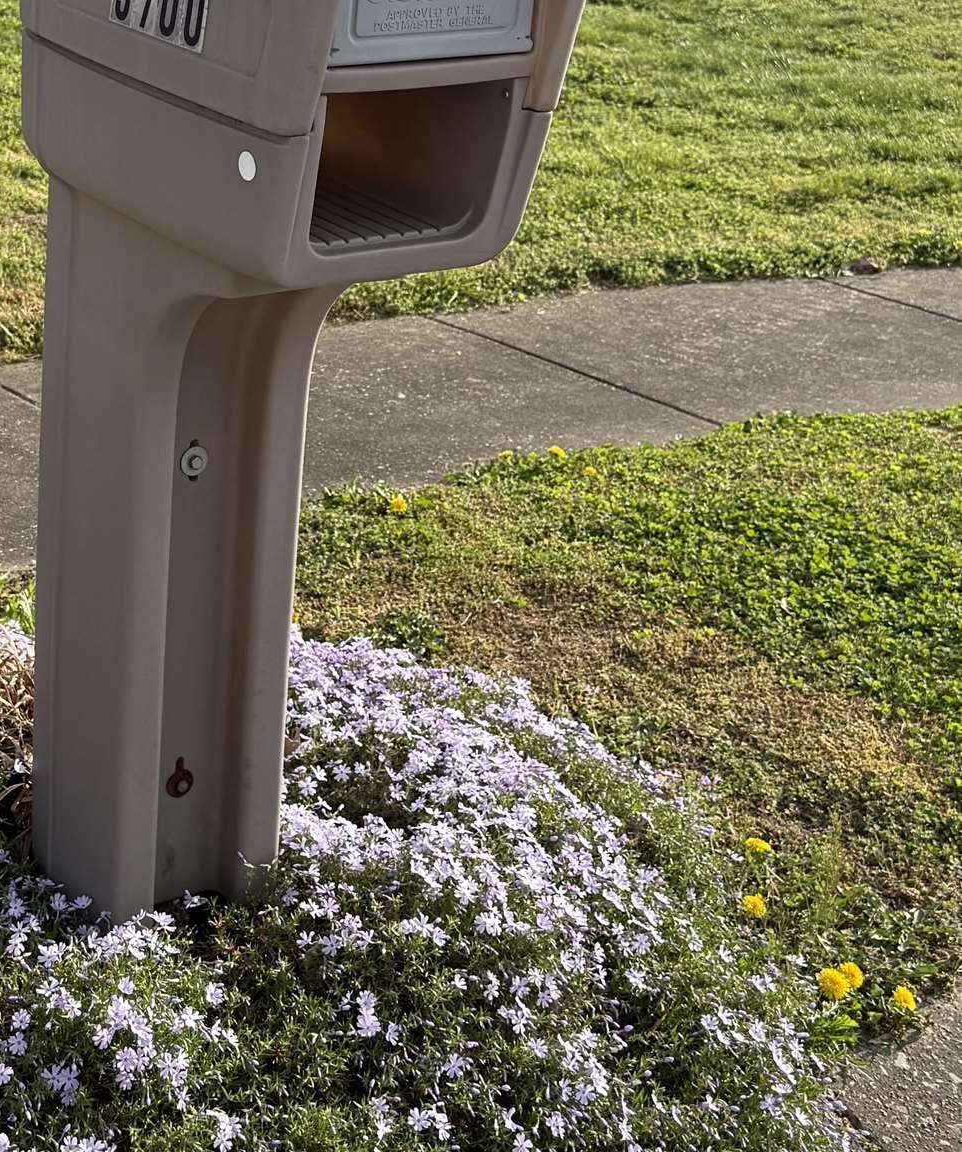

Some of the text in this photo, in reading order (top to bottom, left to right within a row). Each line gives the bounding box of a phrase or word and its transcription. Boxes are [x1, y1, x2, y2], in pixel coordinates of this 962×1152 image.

[386, 4, 485, 21] APPROVED BY THE
[373, 16, 493, 32] POSTMASTER GENERAL
